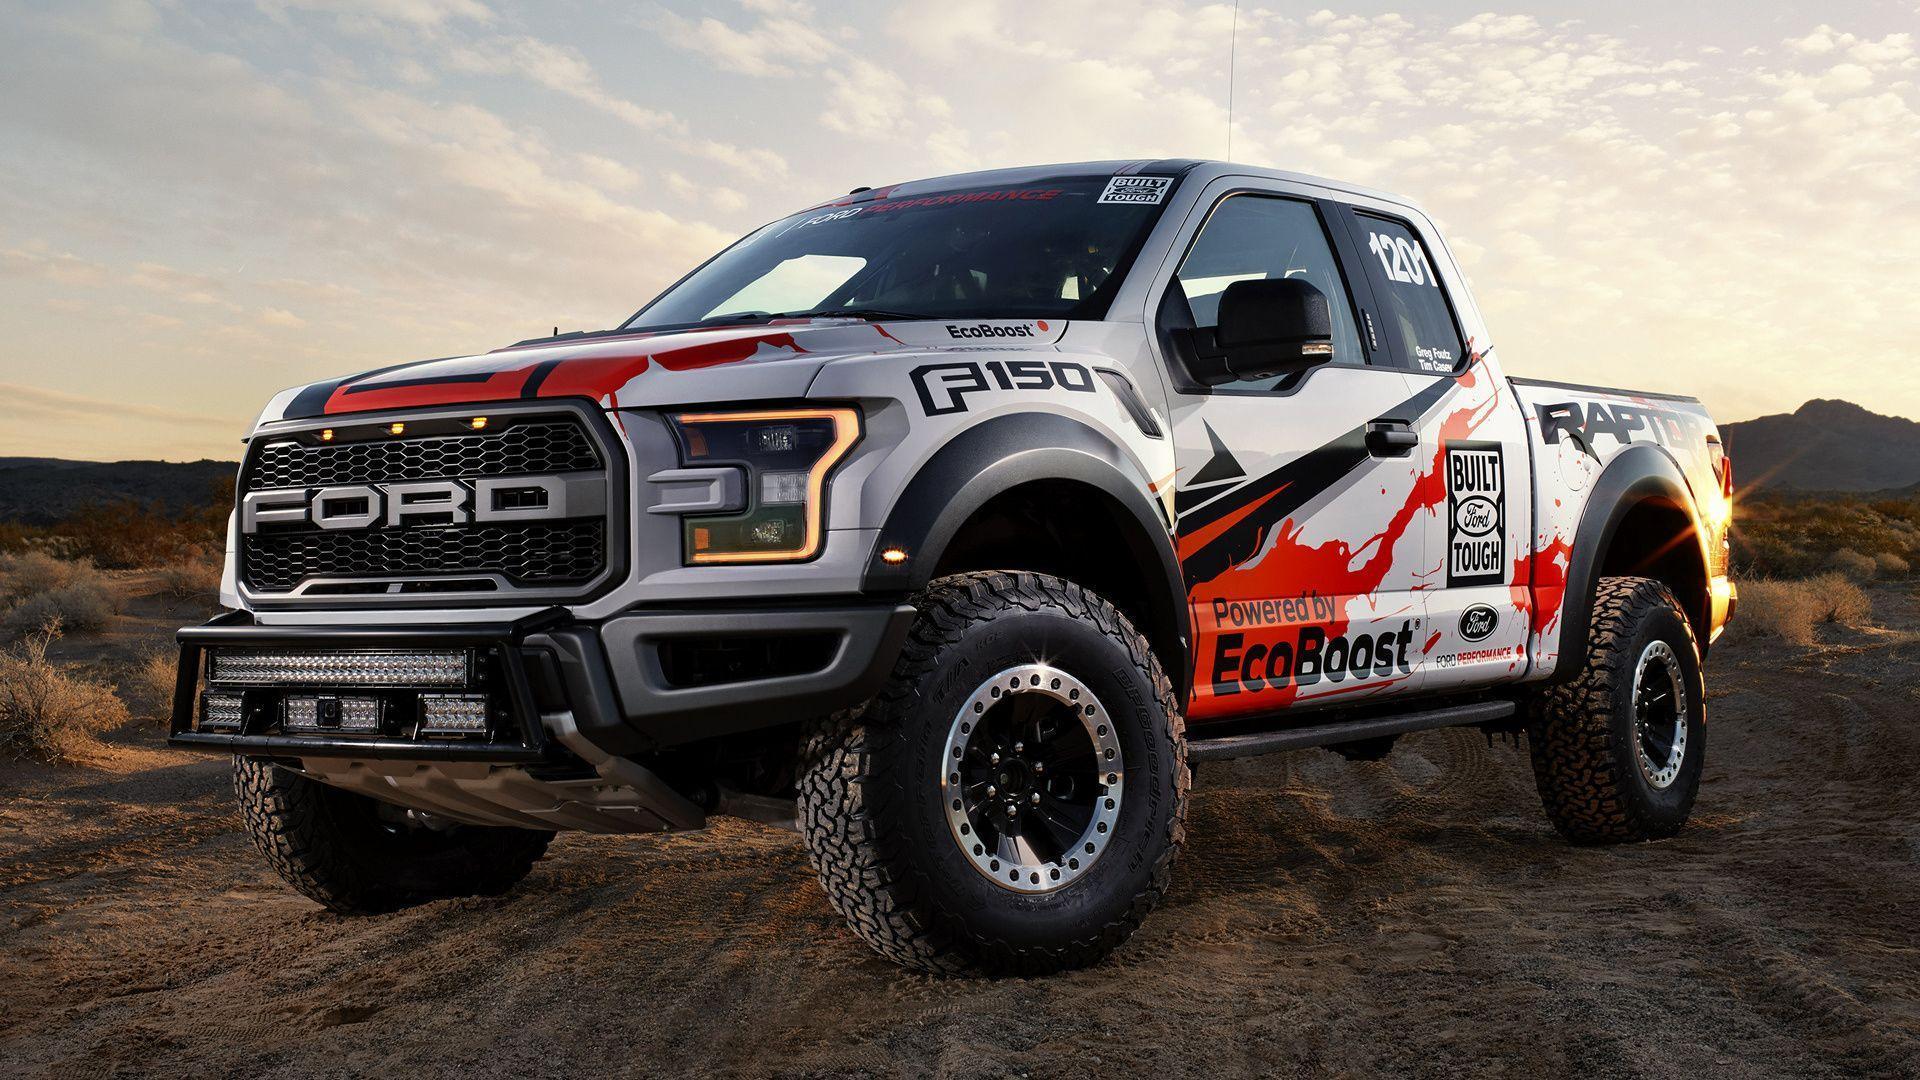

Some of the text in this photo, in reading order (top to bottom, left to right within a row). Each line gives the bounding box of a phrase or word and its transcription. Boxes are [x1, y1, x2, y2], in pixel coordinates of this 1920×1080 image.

[1114, 179, 1167, 187] BUILT
[798, 189, 1064, 229] FORD PERFORMANCE
[1107, 194, 1157, 202] TOUGH
[1368, 232, 1438, 287] 1201
[1415, 345, 1434, 361] Greg
[1418, 359, 1434, 371] Tim
[1452, 454, 1499, 492] BUILT
[242, 476, 566, 535] FORD
[1464, 505, 1491, 529] Ford
[1453, 540, 1500, 572] TOUGH
[1212, 590, 1337, 628] Powered by
[1466, 611, 1492, 634] Ford
[1436, 647, 1512, 668] FORD PERFORMANCE
